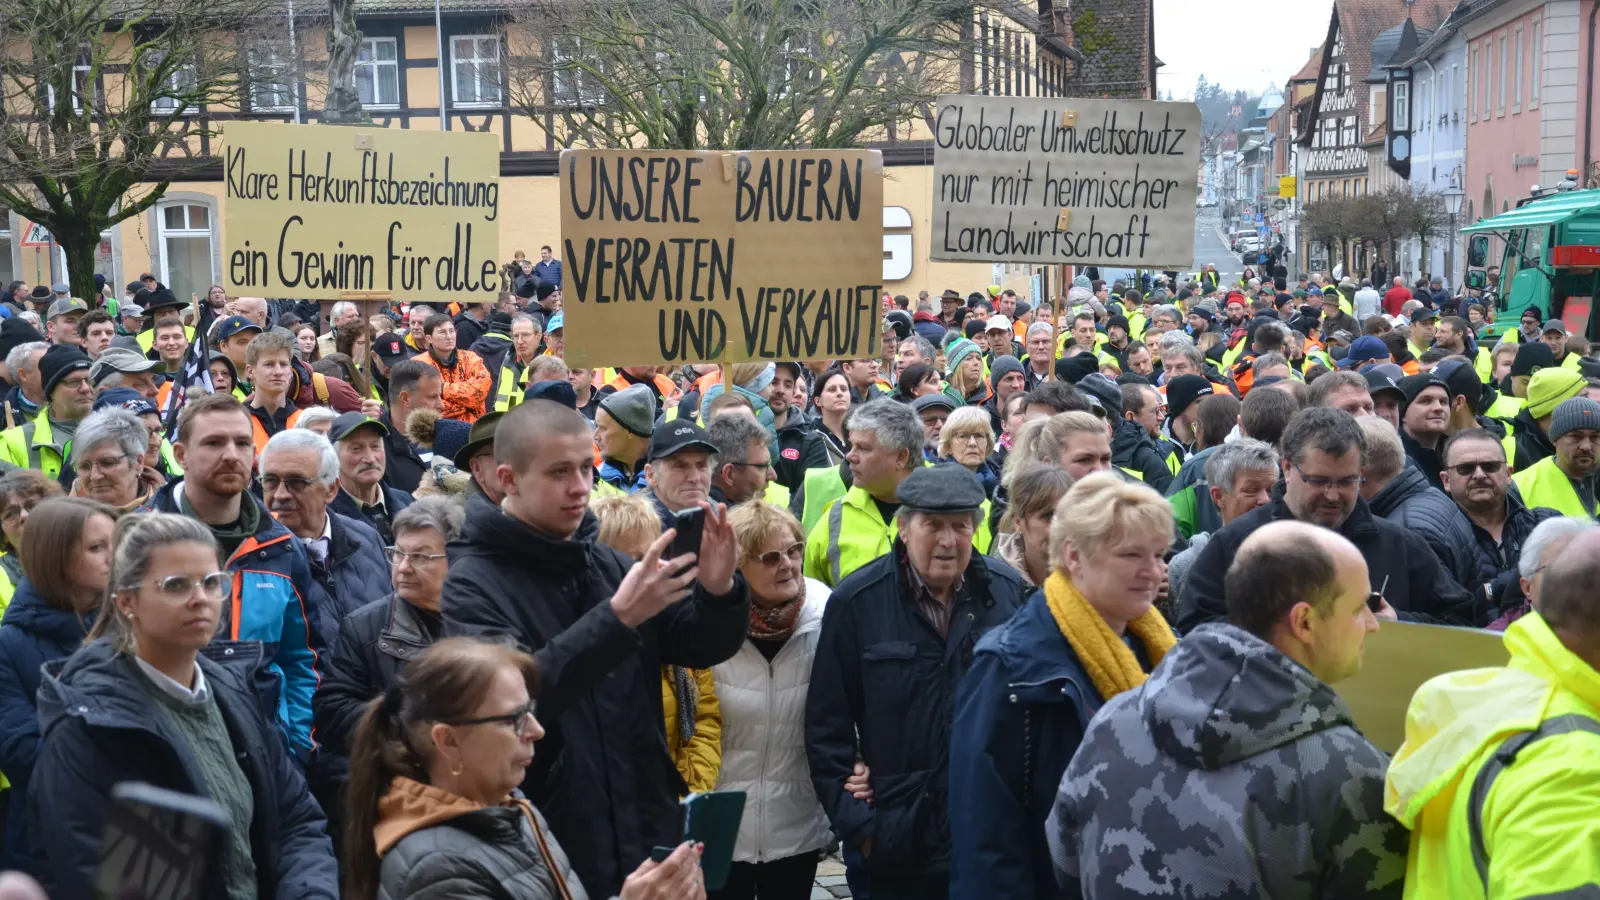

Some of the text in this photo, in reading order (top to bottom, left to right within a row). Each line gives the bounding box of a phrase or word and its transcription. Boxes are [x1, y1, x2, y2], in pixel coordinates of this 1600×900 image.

[936, 105, 1187, 155] Globaler Umweltschutz
[227, 145, 499, 221] Klare Herkunftsbezeichnung
[569, 156, 863, 223] UNSERE BAUERN
[941, 160, 1178, 209] nur mit heimischer
[230, 240, 268, 287] ein
[277, 215, 374, 290] Gewinn
[435, 222, 497, 293] alle
[943, 211, 1150, 258] Landwirtschaft
[564, 237, 735, 303] VERRATEN
[658, 285, 883, 361] UND VERKAUFT
